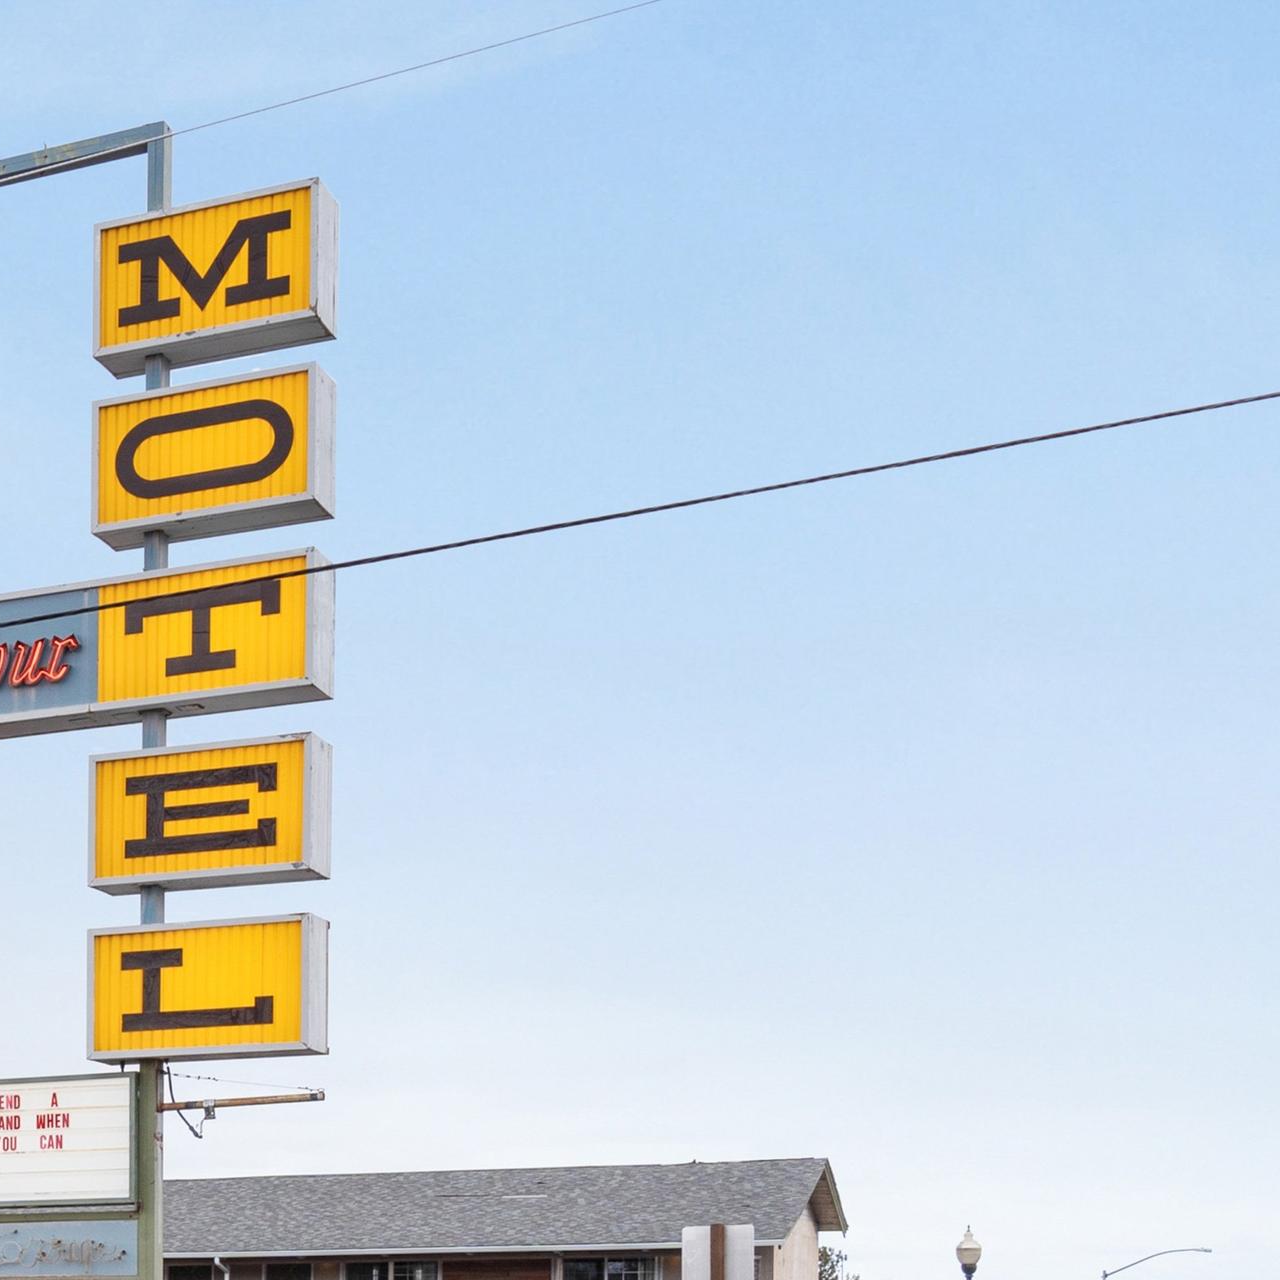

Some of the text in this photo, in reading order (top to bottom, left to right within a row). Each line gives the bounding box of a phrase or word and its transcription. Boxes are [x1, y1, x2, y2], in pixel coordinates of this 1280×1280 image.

[115, 208, 294, 1032] MOTEL
[50, 1092, 59, 1108] A
[36, 1113, 70, 1129] WHEN
[39, 1134, 64, 1150] CAN
